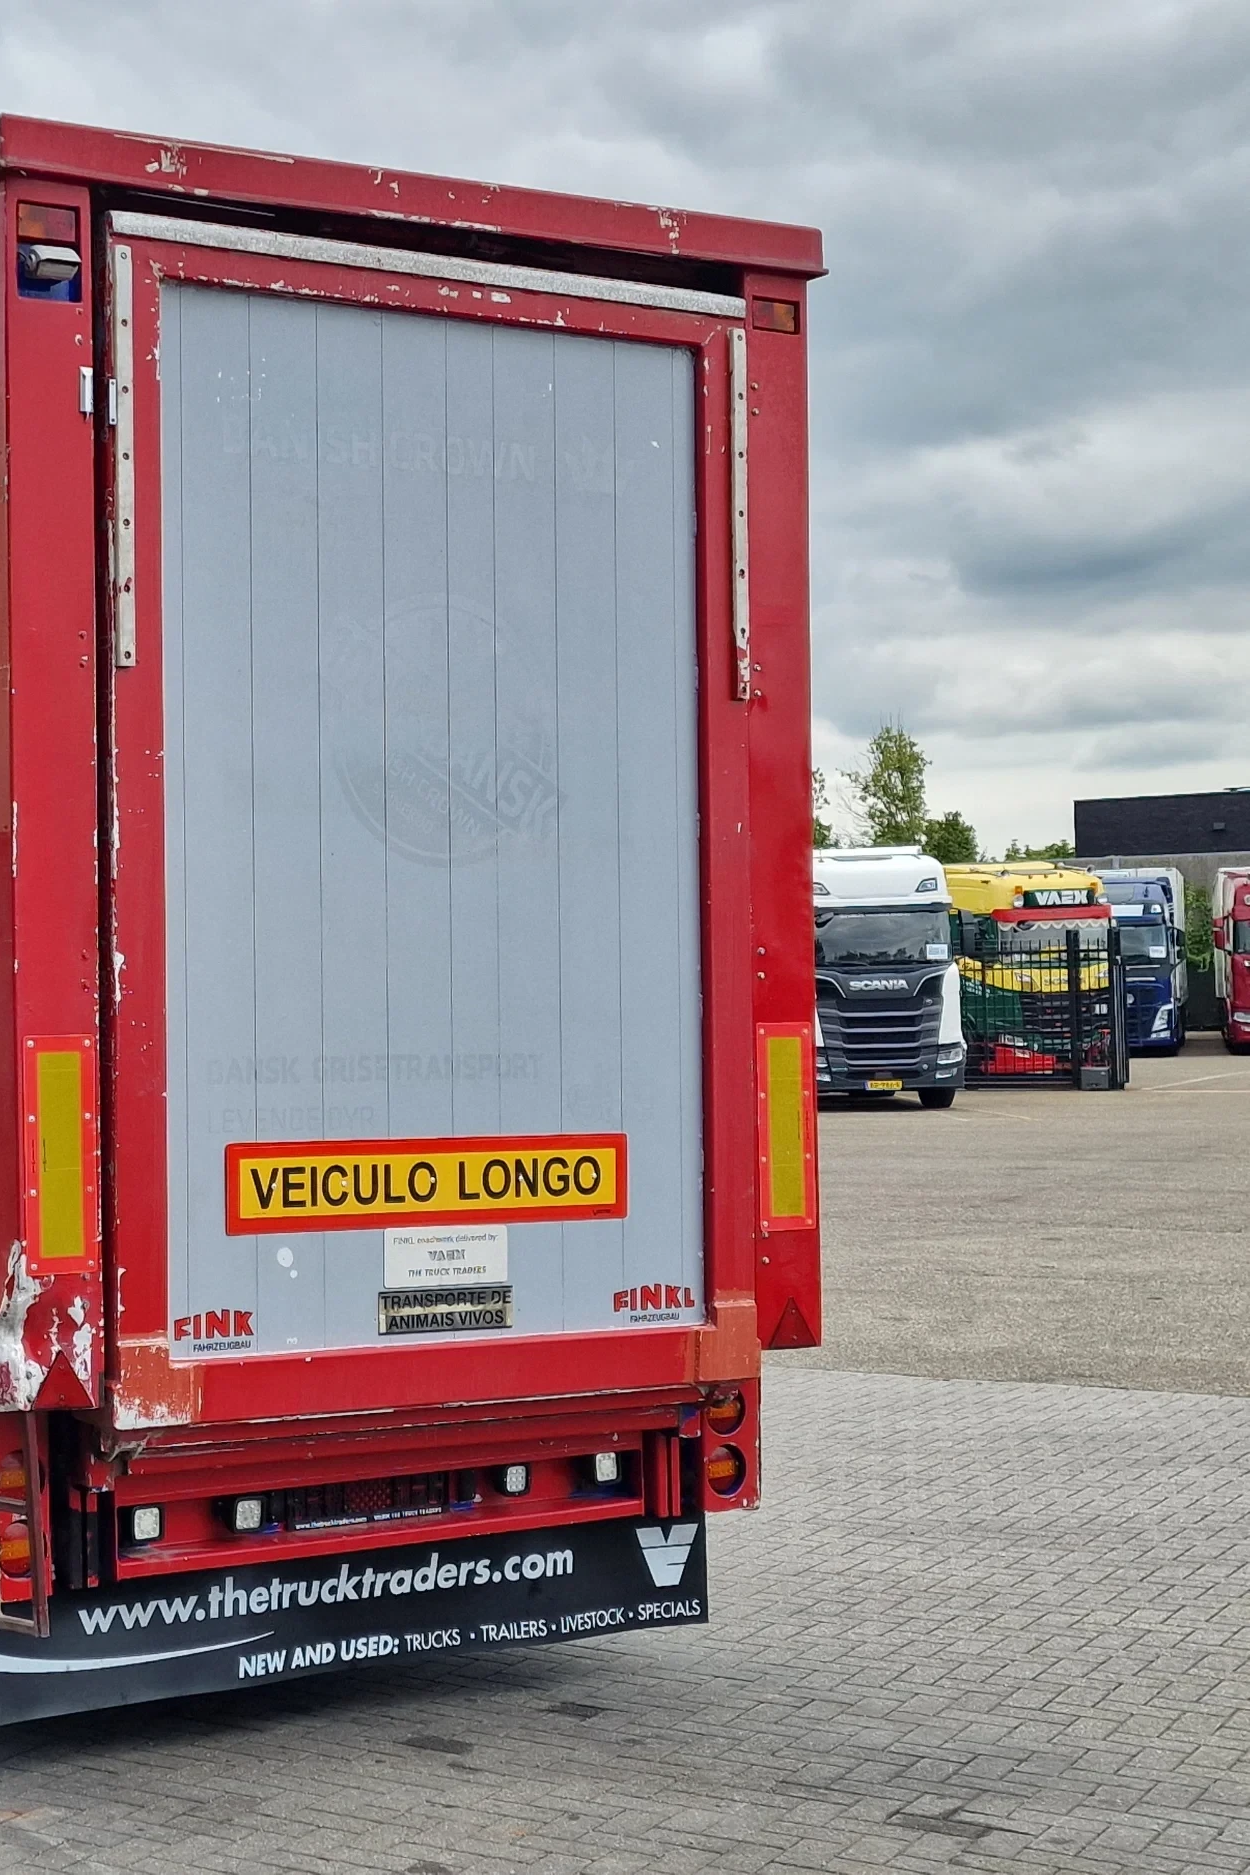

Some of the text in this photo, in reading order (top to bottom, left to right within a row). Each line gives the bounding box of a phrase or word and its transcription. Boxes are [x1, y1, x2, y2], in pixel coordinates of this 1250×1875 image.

[1035, 890, 1088, 905] VAEX
[849, 979, 909, 991] SCANIA
[250, 1155, 601, 1209] VEICULO LONGO
[424, 1268, 451, 1277] TRUCK
[453, 1265, 487, 1276] TRADERS
[381, 1289, 512, 1310] TRANSPORTE DE
[613, 1283, 695, 1313] FINKL
[174, 1309, 254, 1341] FINK
[388, 1309, 504, 1330] ANIMAIS VIVOS
[193, 1340, 251, 1353] FAHRZEUGBAU
[78, 1549, 573, 1635] www.thetrucktraders.com
[238, 1599, 701, 1679] NEW AND USED: TRUCKS TRAILERS LIVESTOCK SPECIALS
